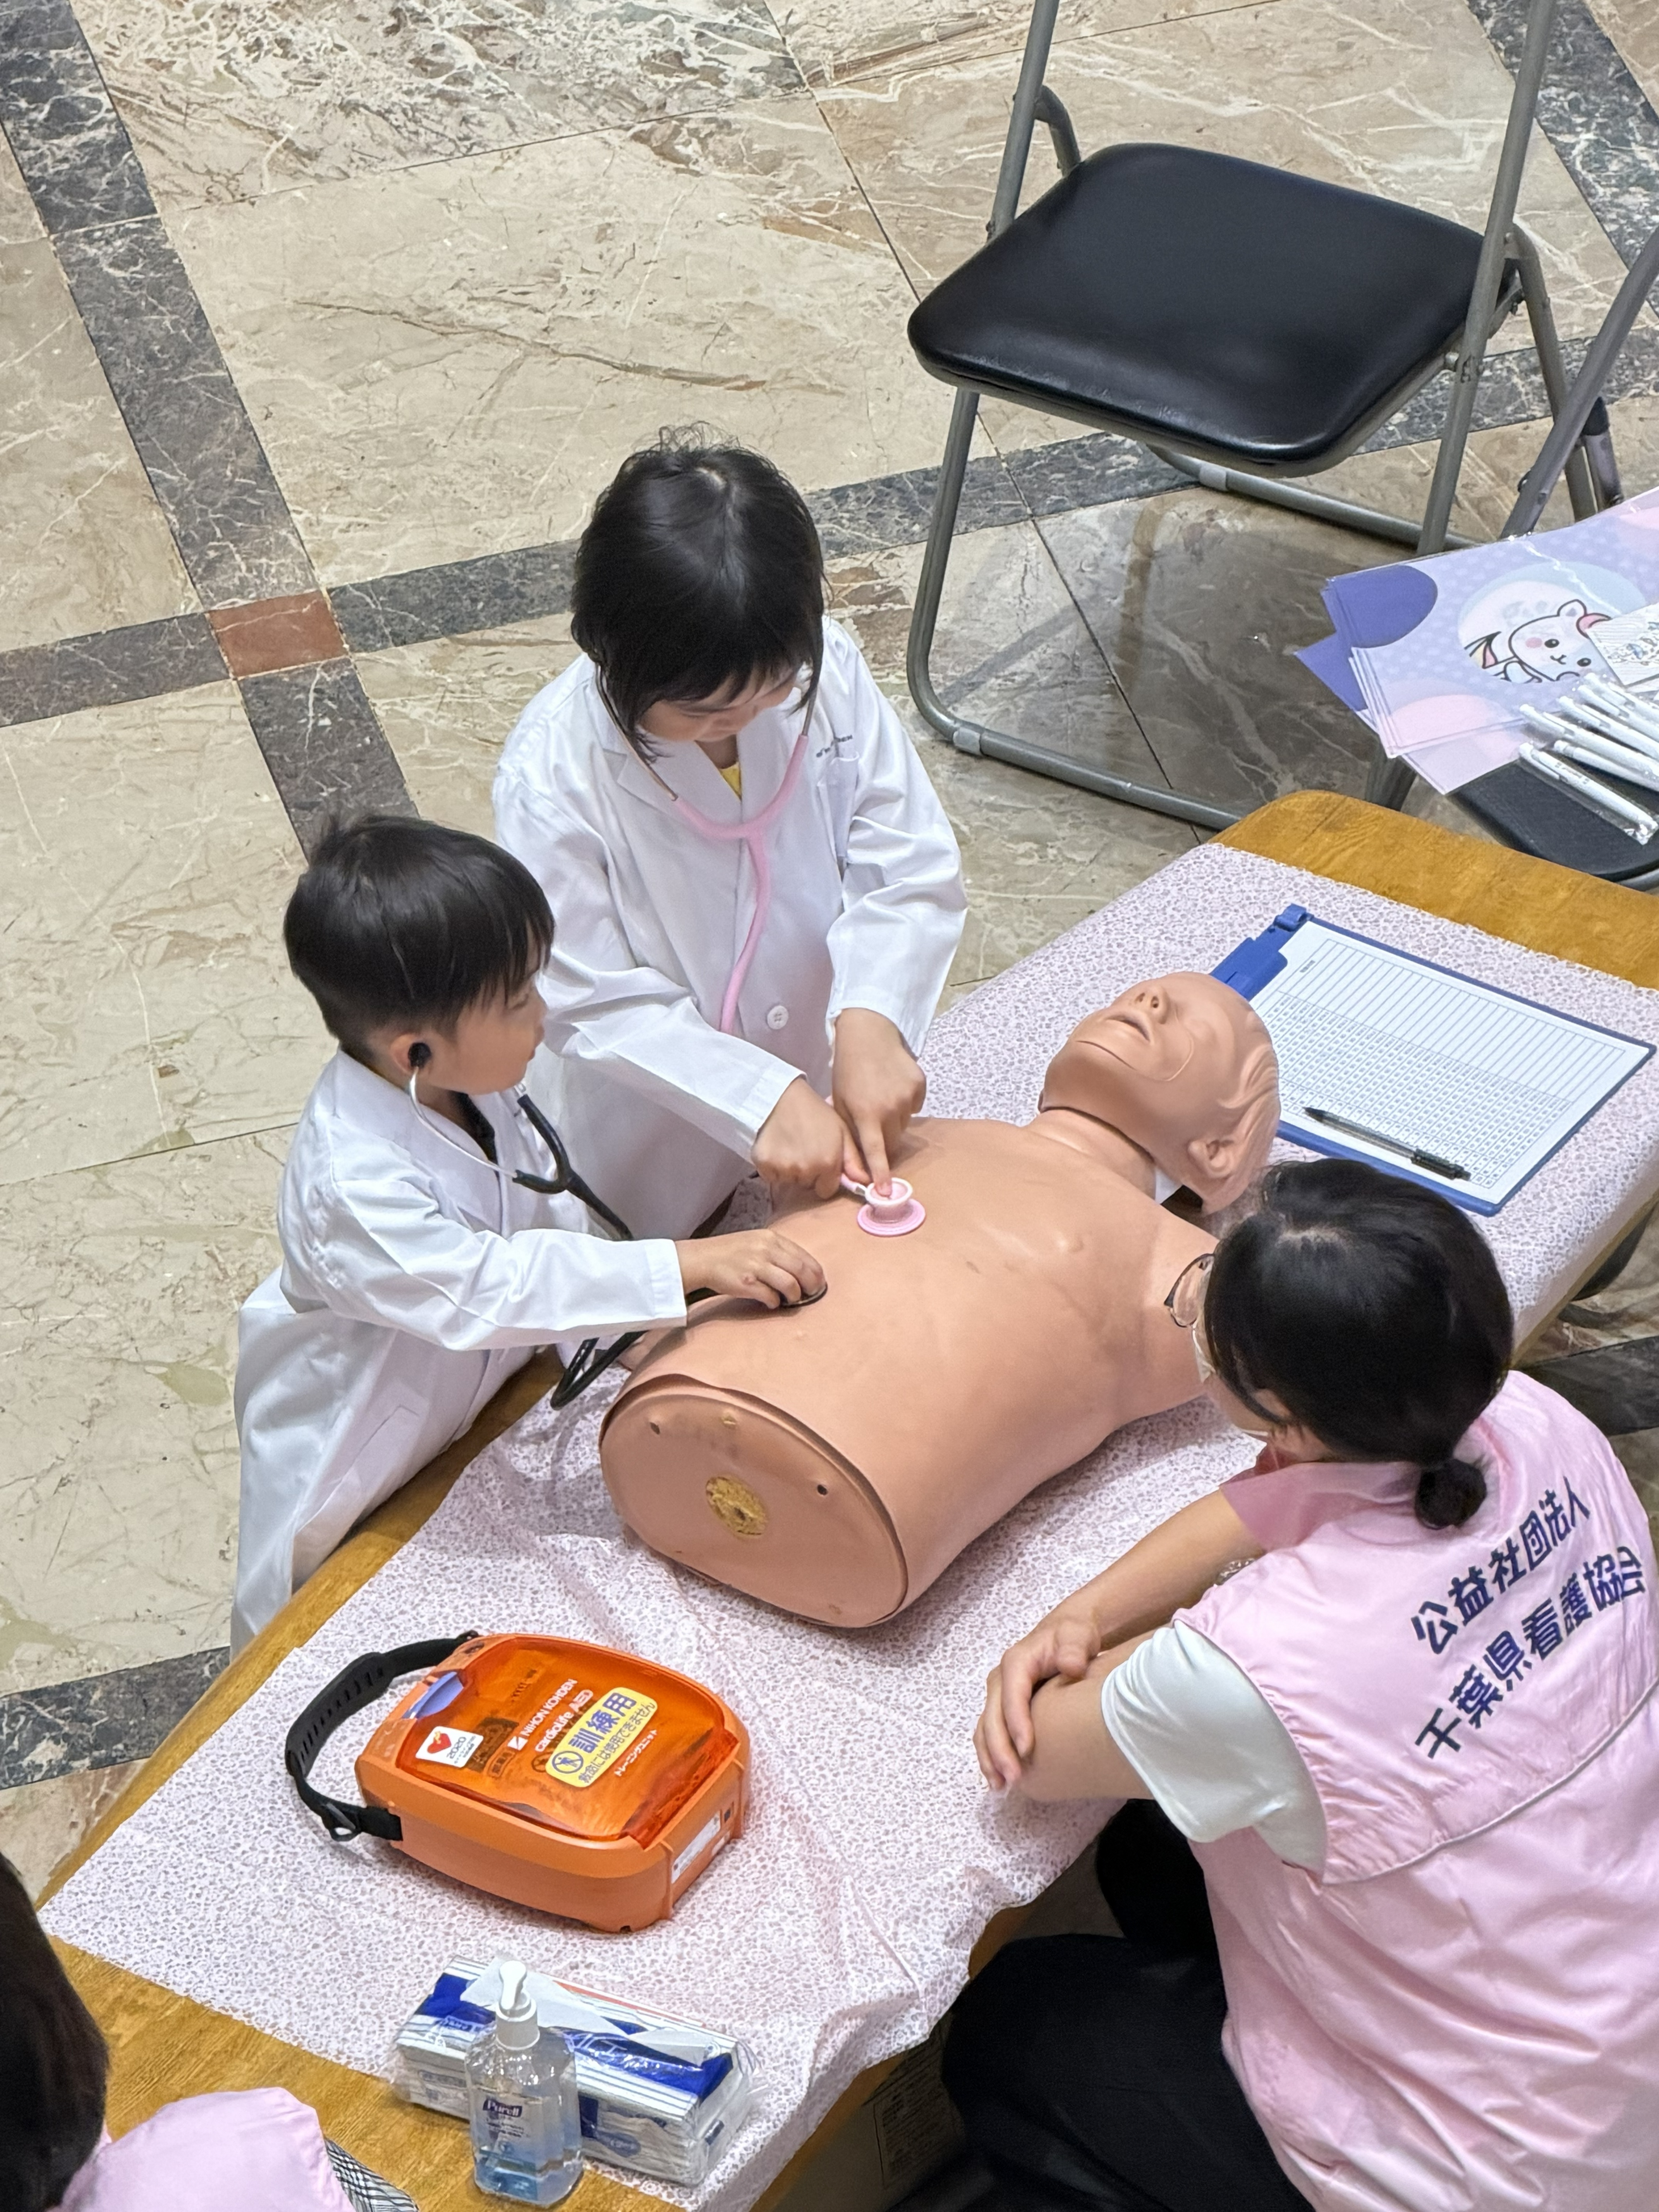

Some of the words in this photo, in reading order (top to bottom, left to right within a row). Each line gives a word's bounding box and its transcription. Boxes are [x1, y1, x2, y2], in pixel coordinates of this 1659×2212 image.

[1411, 1476, 1590, 1654] 公益社団法人
[1415, 1546, 1646, 1759] 千葉県看護協会
[520, 1709, 550, 1736] NIHON
[543, 1678, 578, 1710] KOHDEN
[568, 1692, 637, 1753] 訓練用
[569, 1689, 594, 1712] AED
[579, 1702, 656, 1783] 救命には使用できません
